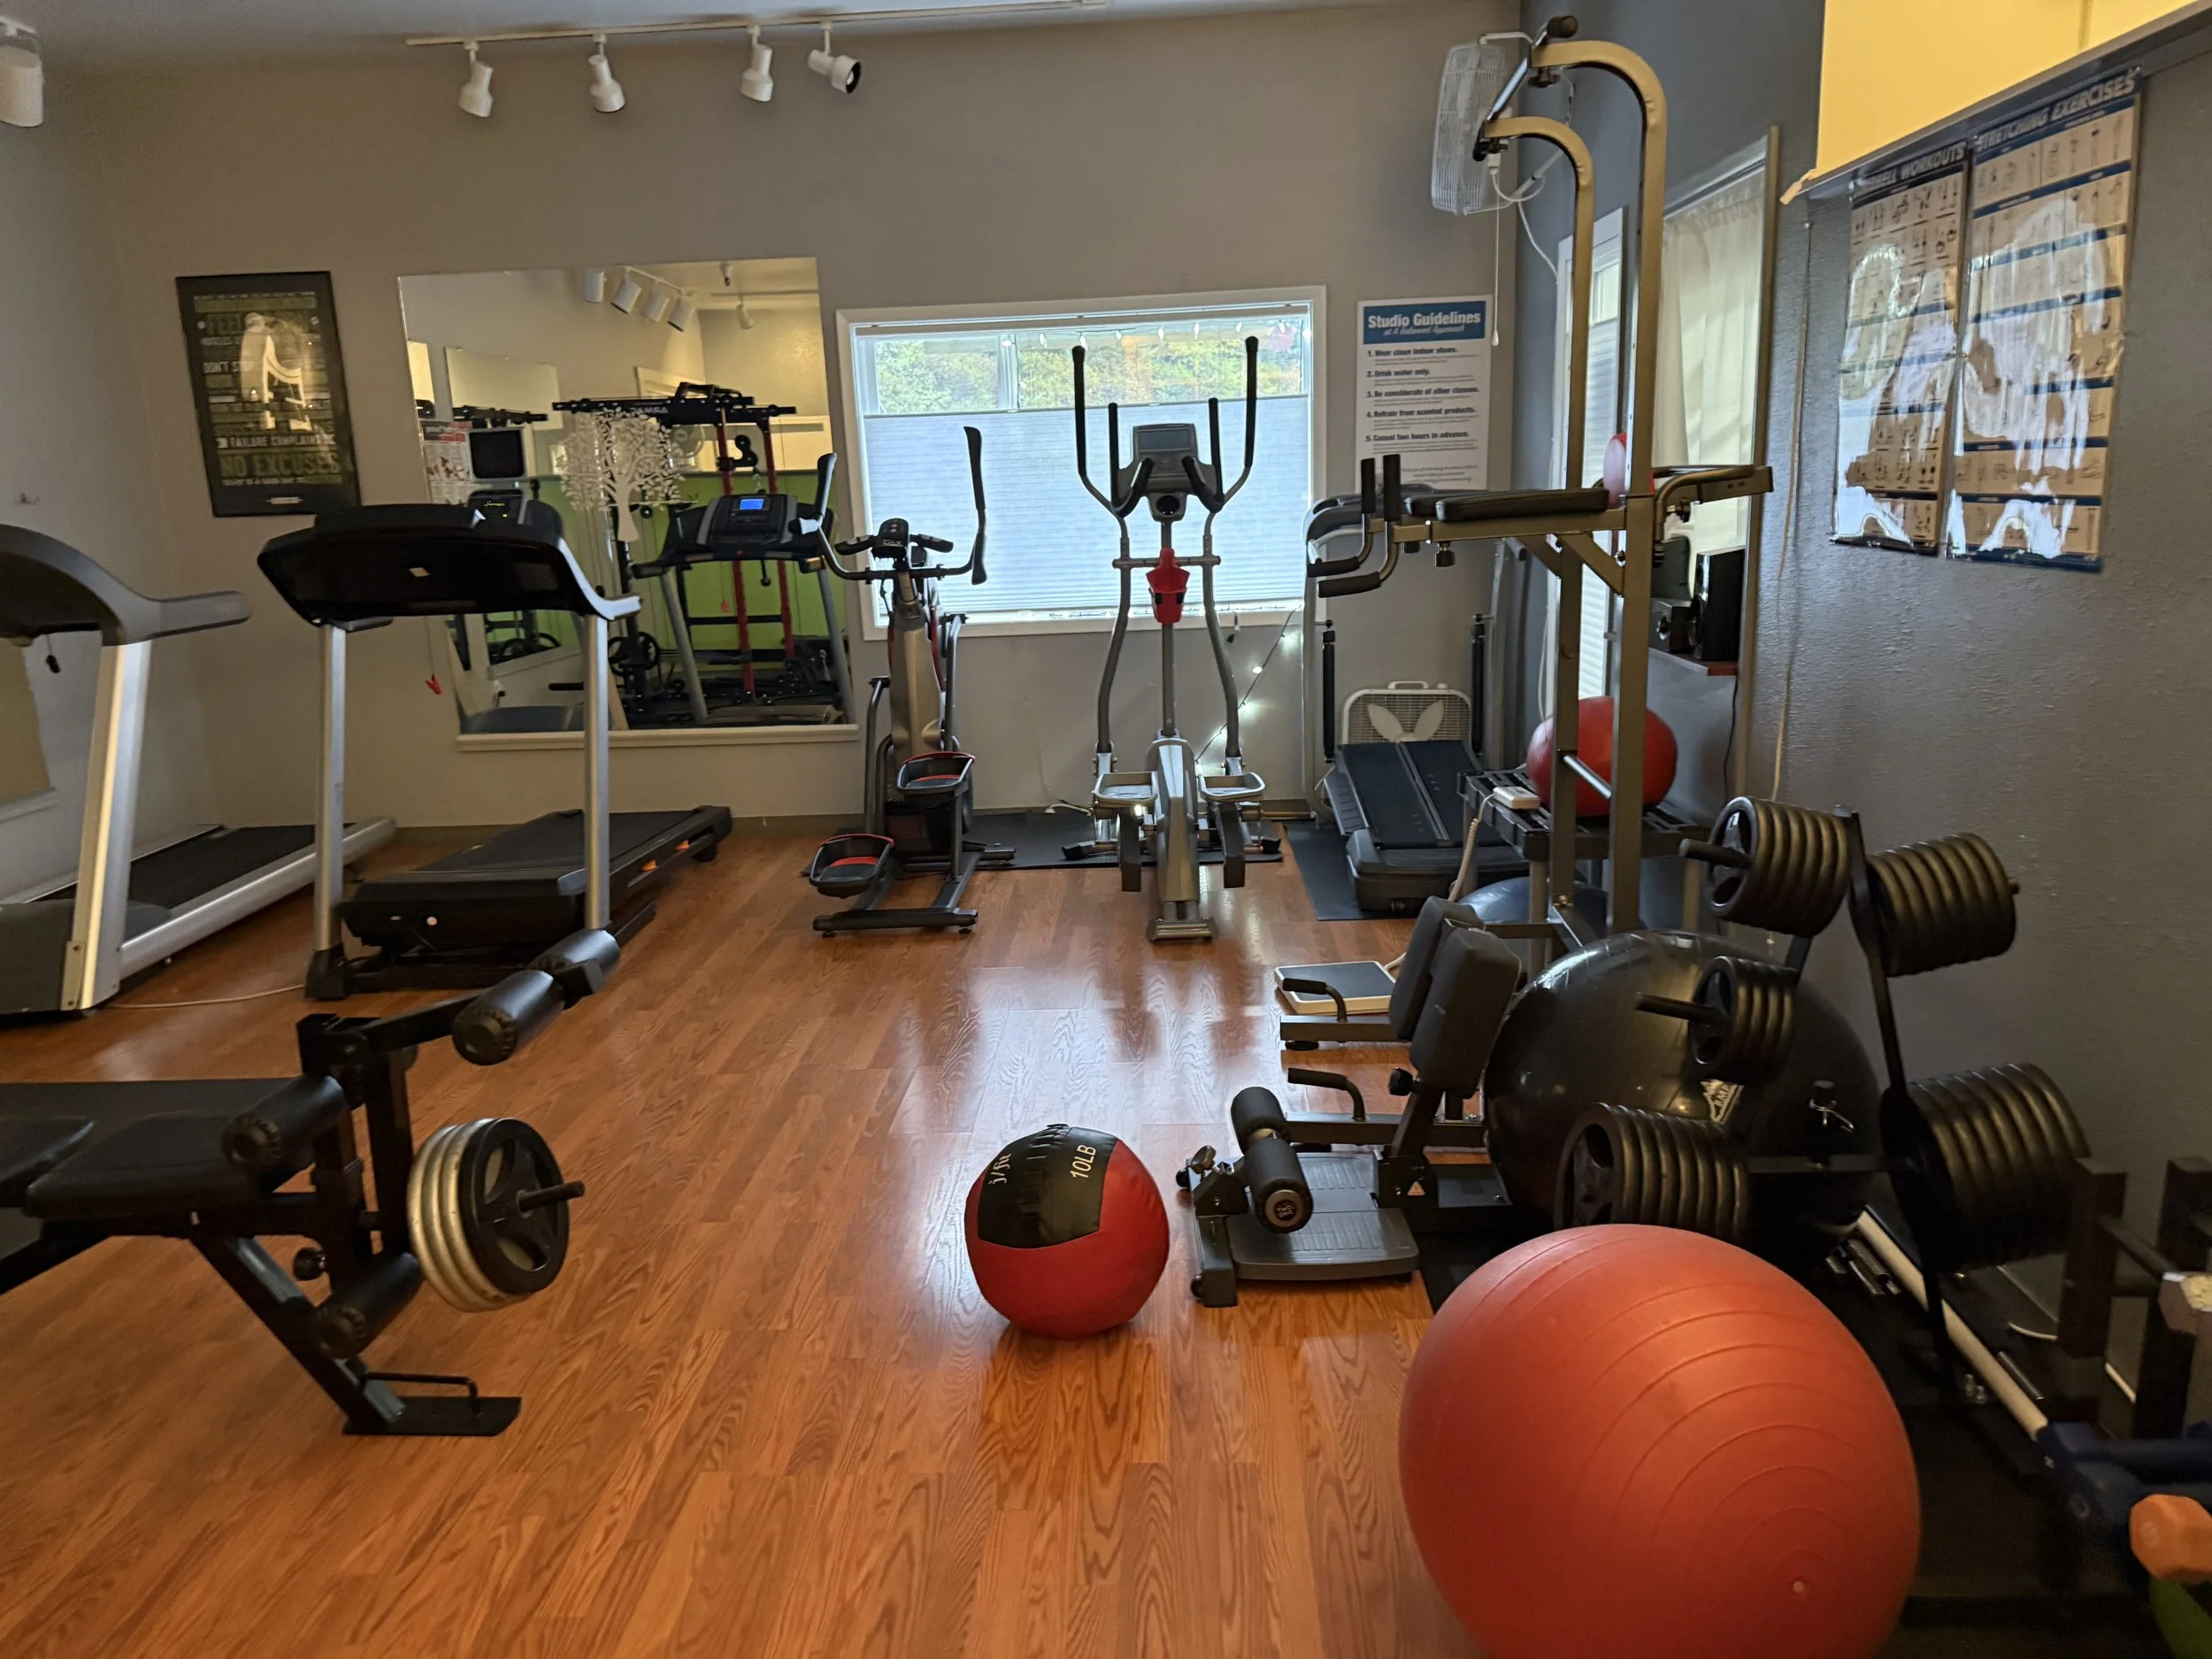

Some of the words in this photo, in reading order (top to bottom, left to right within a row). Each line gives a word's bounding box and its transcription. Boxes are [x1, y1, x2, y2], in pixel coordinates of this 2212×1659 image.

[2051, 74, 2135, 121] EXERCISES
[1368, 313, 1409, 328] Studio
[1413, 311, 1481, 326] Guidelines
[221, 456, 247, 477] NO
[252, 453, 340, 476] EXCUSES
[1070, 1145, 1097, 1178] 10LB
